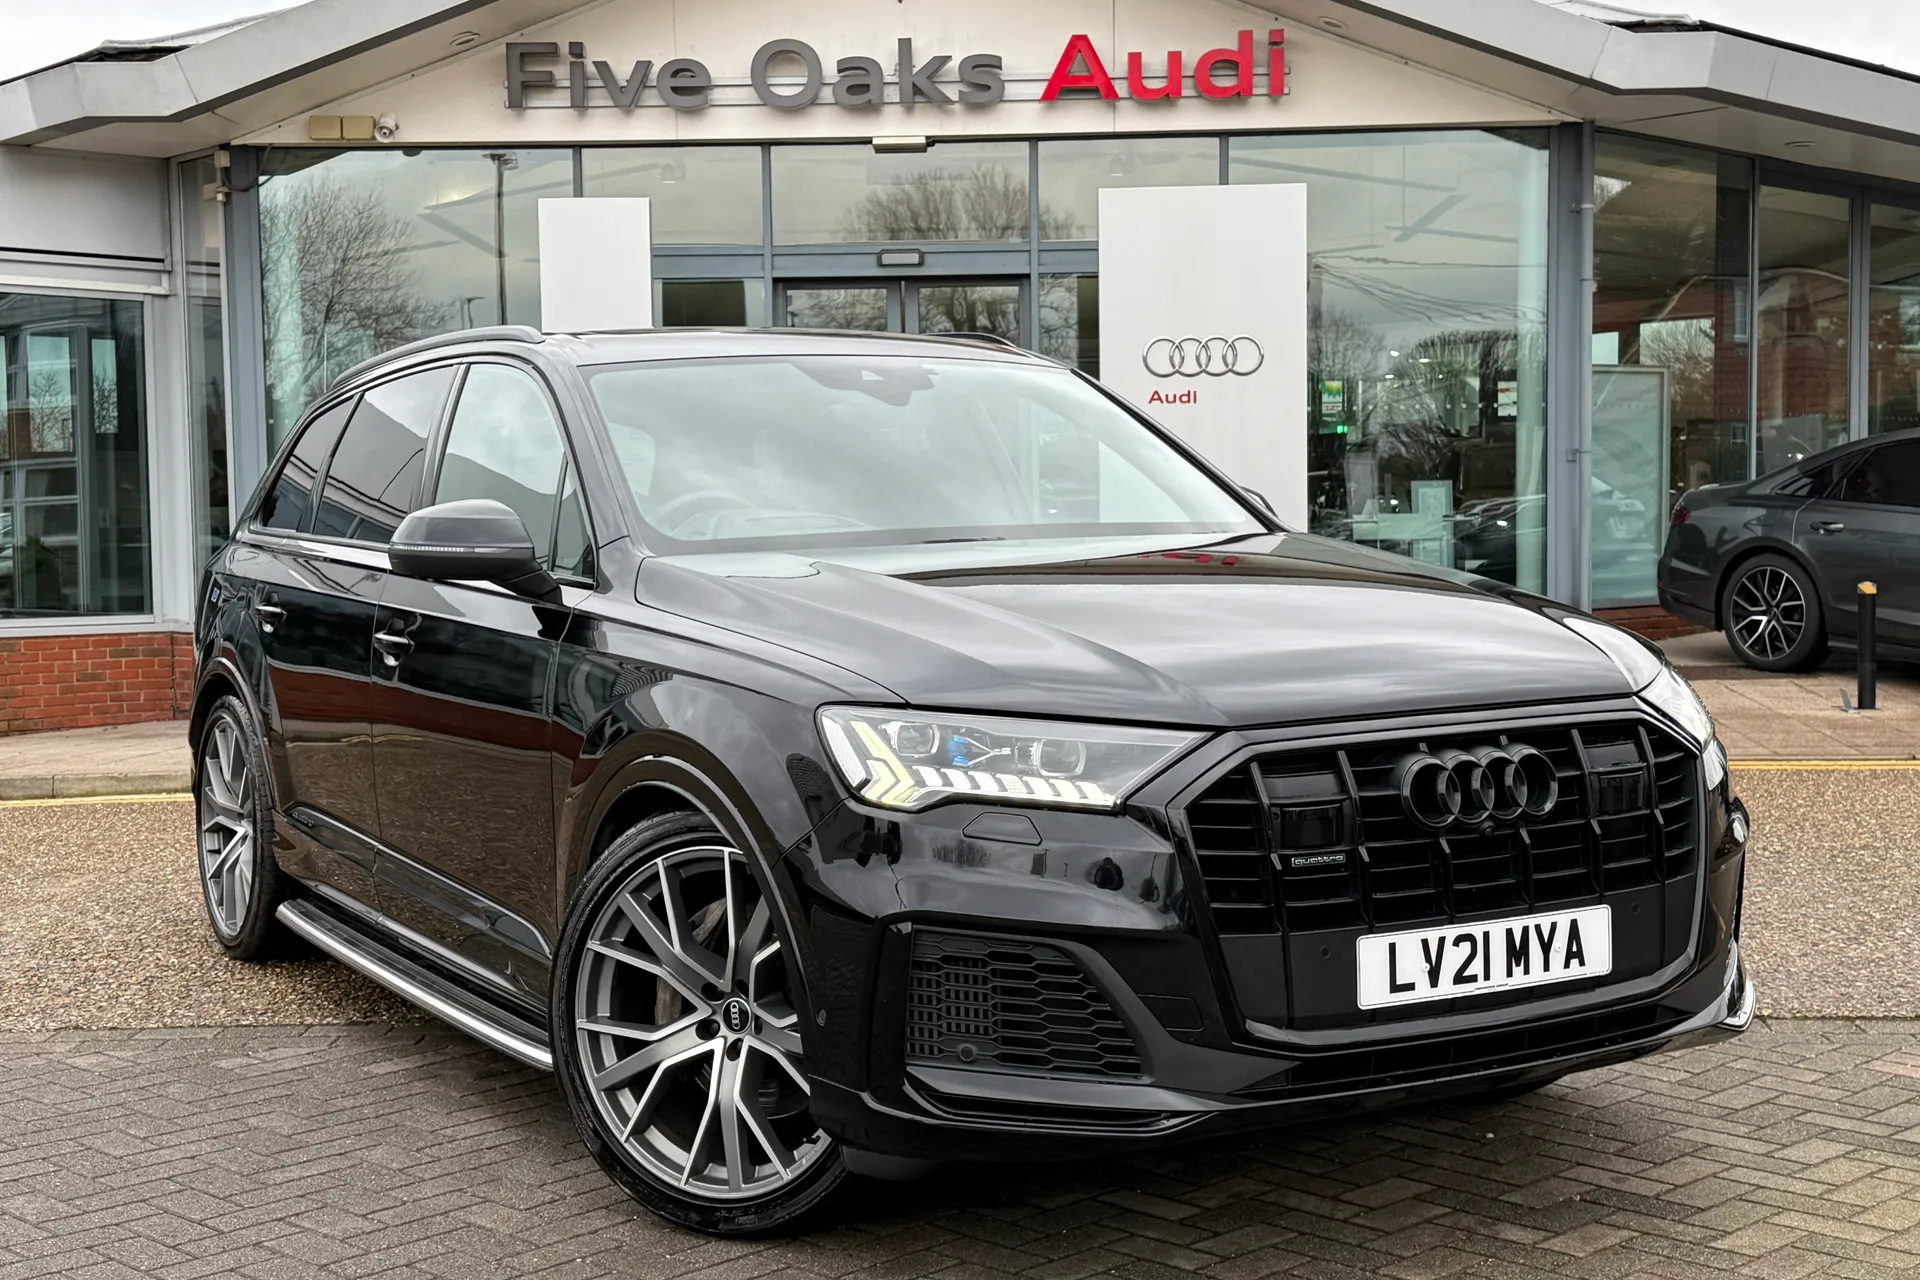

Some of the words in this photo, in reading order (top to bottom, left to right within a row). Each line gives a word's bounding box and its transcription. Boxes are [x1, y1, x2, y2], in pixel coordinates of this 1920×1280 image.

[506, 41, 711, 111] Five
[750, 38, 1006, 109] Oaks
[1040, 29, 1285, 102] Audi
[1148, 389, 1197, 404] Audi
[1294, 855, 1344, 866] quattro
[1388, 930, 1491, 995] LV21
[1505, 918, 1587, 979] MYA
